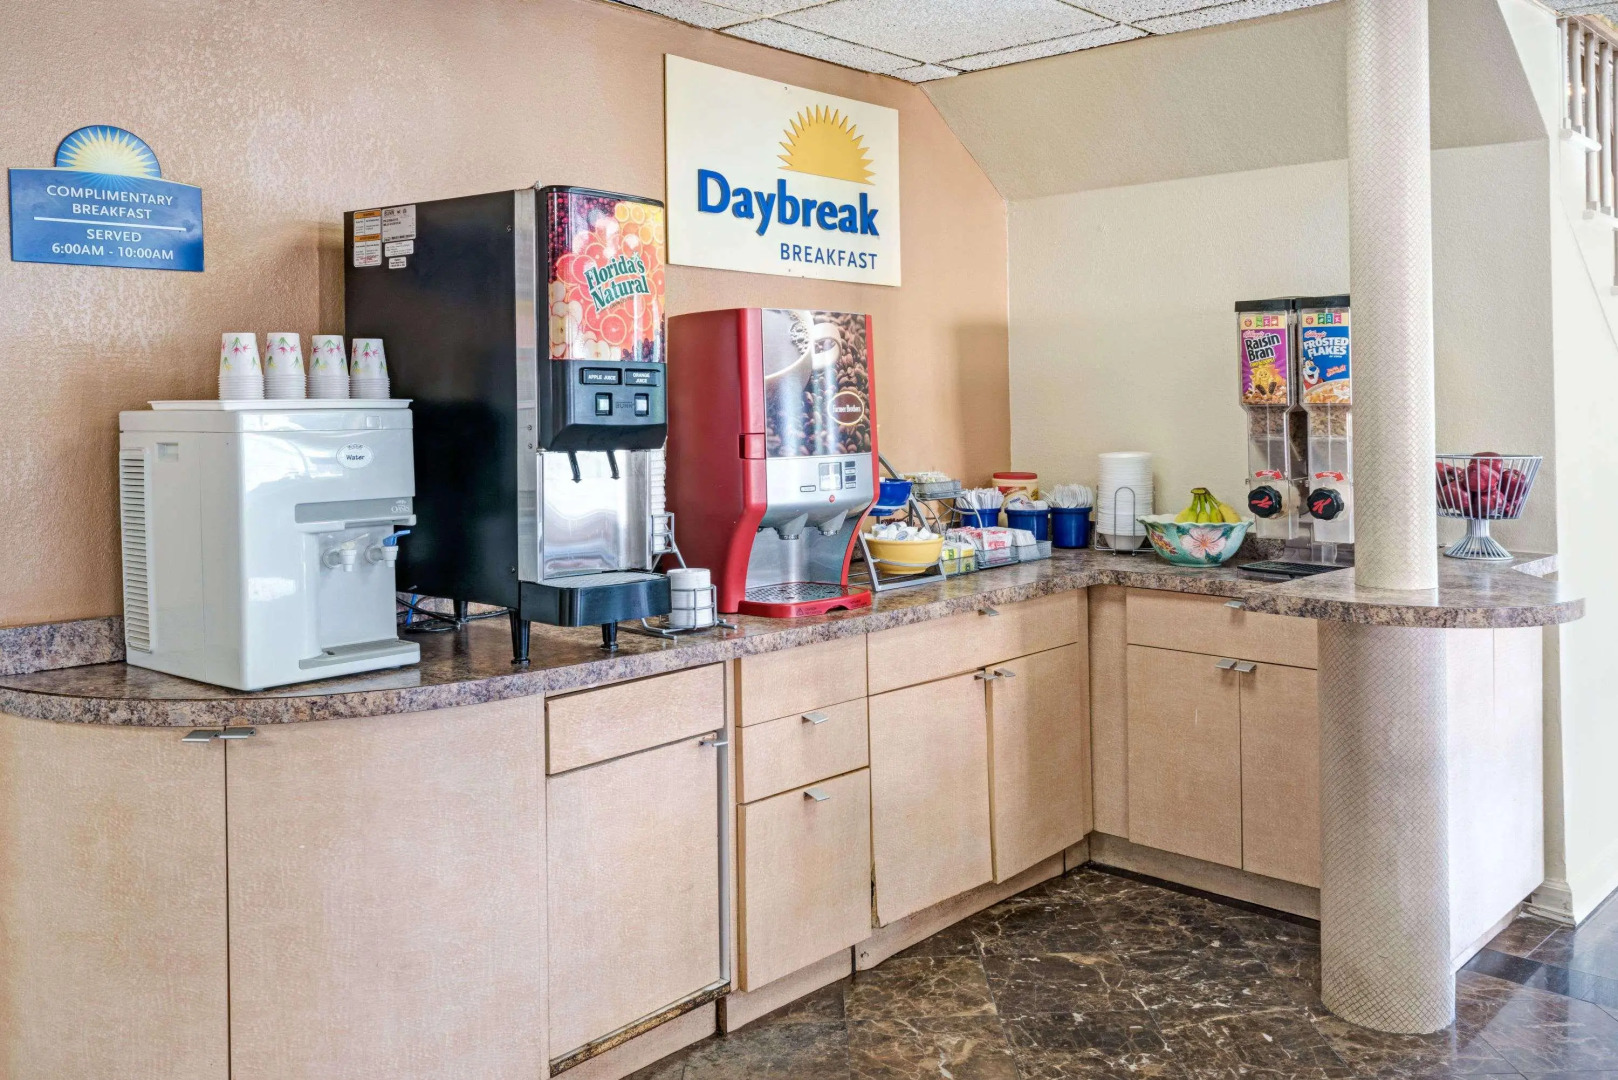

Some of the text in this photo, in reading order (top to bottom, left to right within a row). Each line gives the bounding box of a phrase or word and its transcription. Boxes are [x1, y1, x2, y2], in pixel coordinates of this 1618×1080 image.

[46, 185, 173, 206] COMPLIMENTARY
[698, 168, 880, 236] Daybreak
[72, 203, 152, 220] BREAKFAST
[86, 228, 142, 243] SERVED
[51, 243, 104, 256] 6:00AM
[118, 246, 174, 260] 10:00AM
[780, 243, 878, 270] BREAKFAST
[583, 255, 645, 291] Florida's
[590, 275, 650, 312] Natural
[1245, 334, 1281, 351] Raisin
[1303, 337, 1349, 350] FROSTED
[1247, 346, 1275, 362] Bran
[1308, 346, 1347, 358] FLAKES
